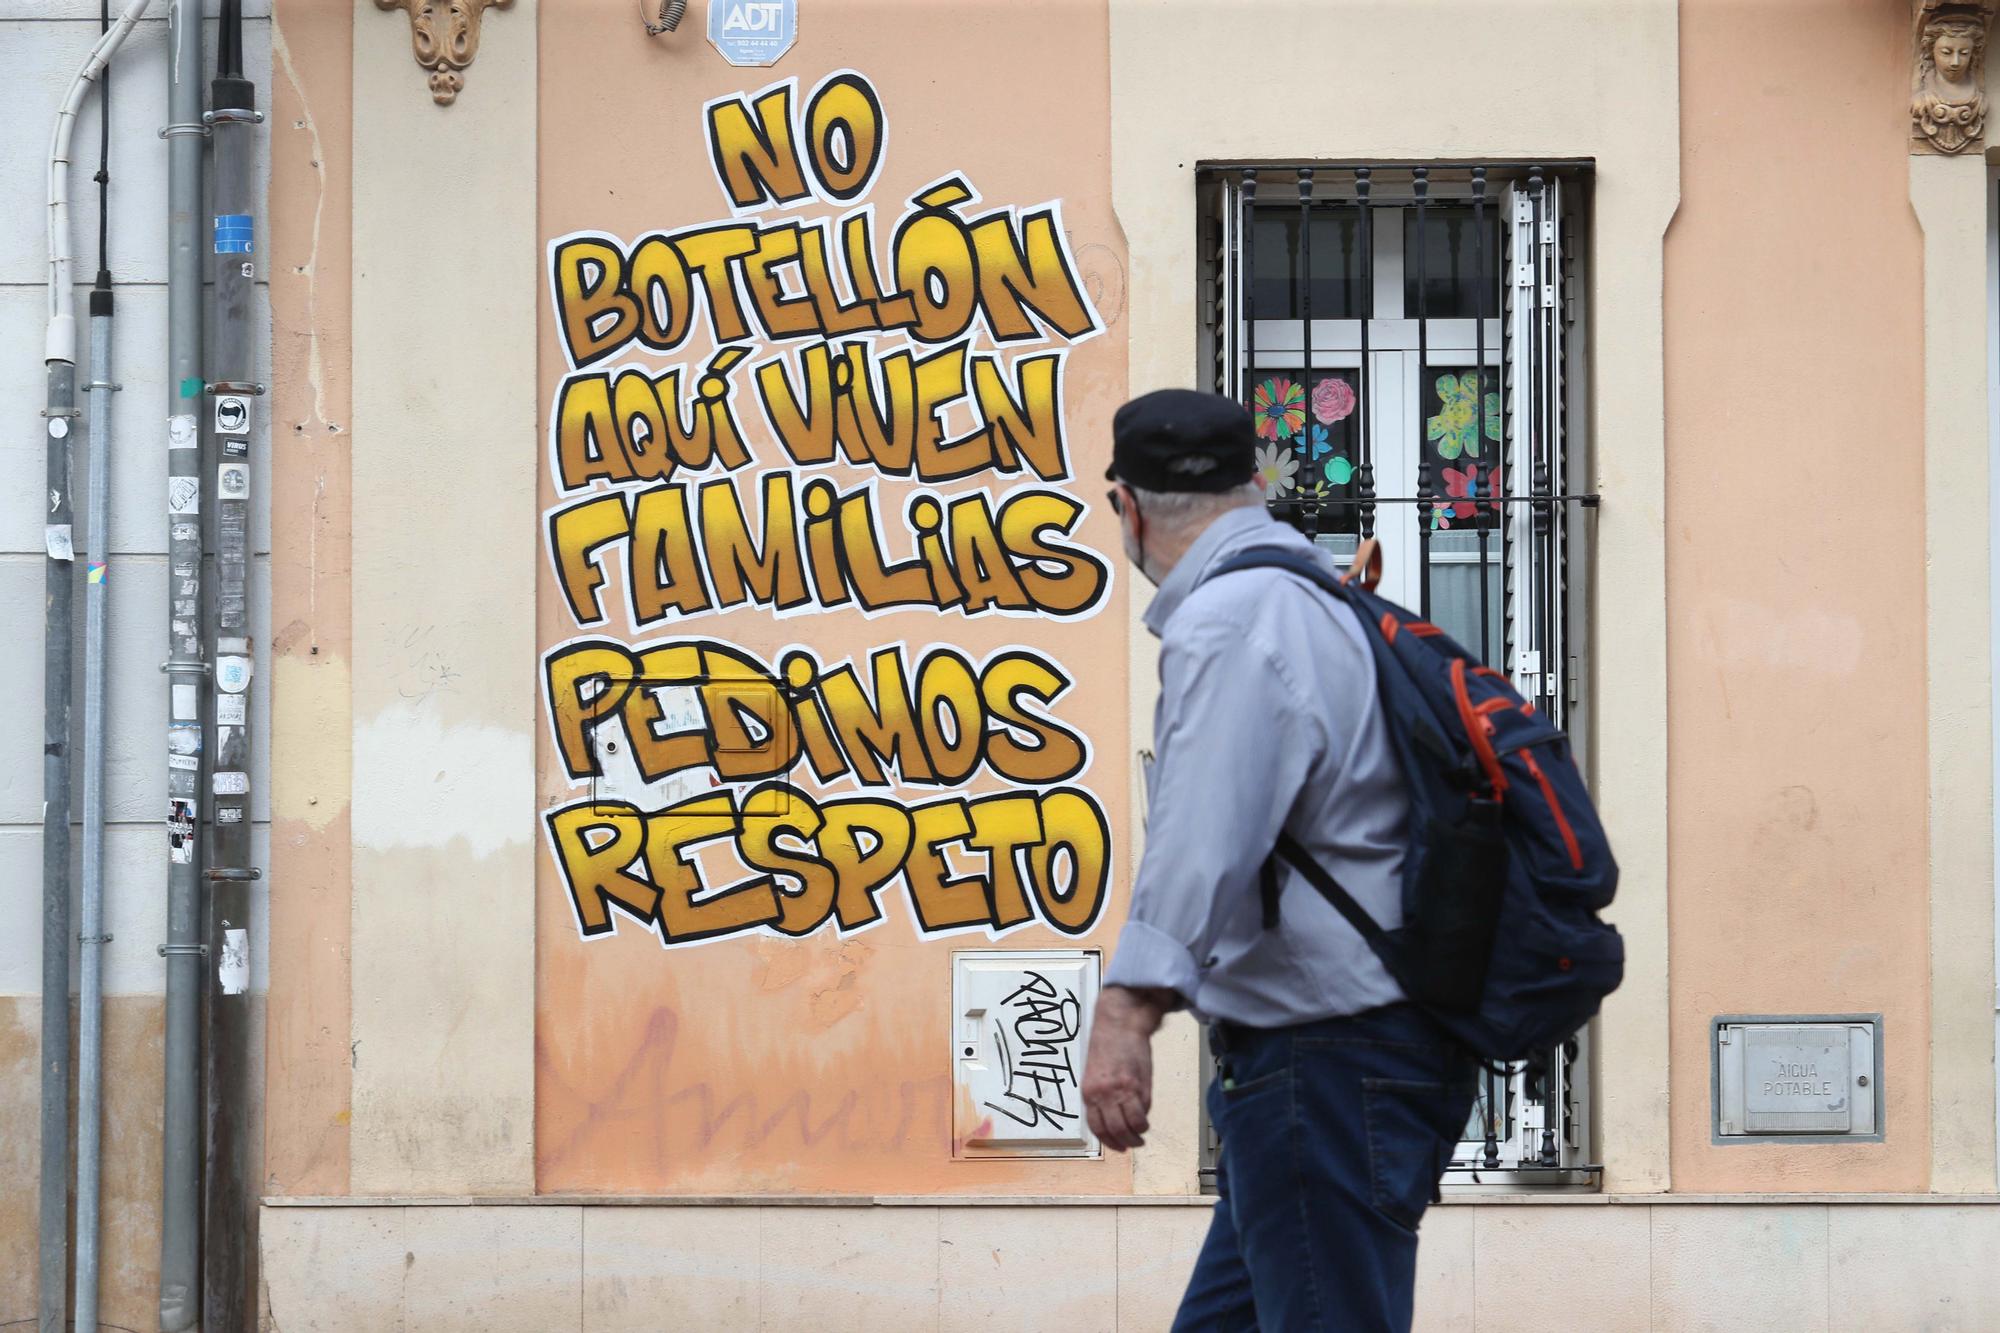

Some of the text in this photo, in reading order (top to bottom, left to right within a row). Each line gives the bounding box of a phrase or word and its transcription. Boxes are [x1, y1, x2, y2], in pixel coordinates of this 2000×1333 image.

[724, 3, 783, 31] ADT
[706, 72, 885, 209] NO
[552, 175, 1098, 369] BOTELLÓN
[546, 781, 1111, 945] RESPETO
[1763, 1081, 1832, 1096] POTABLE
[1778, 1063, 1818, 1078] AIGUA
